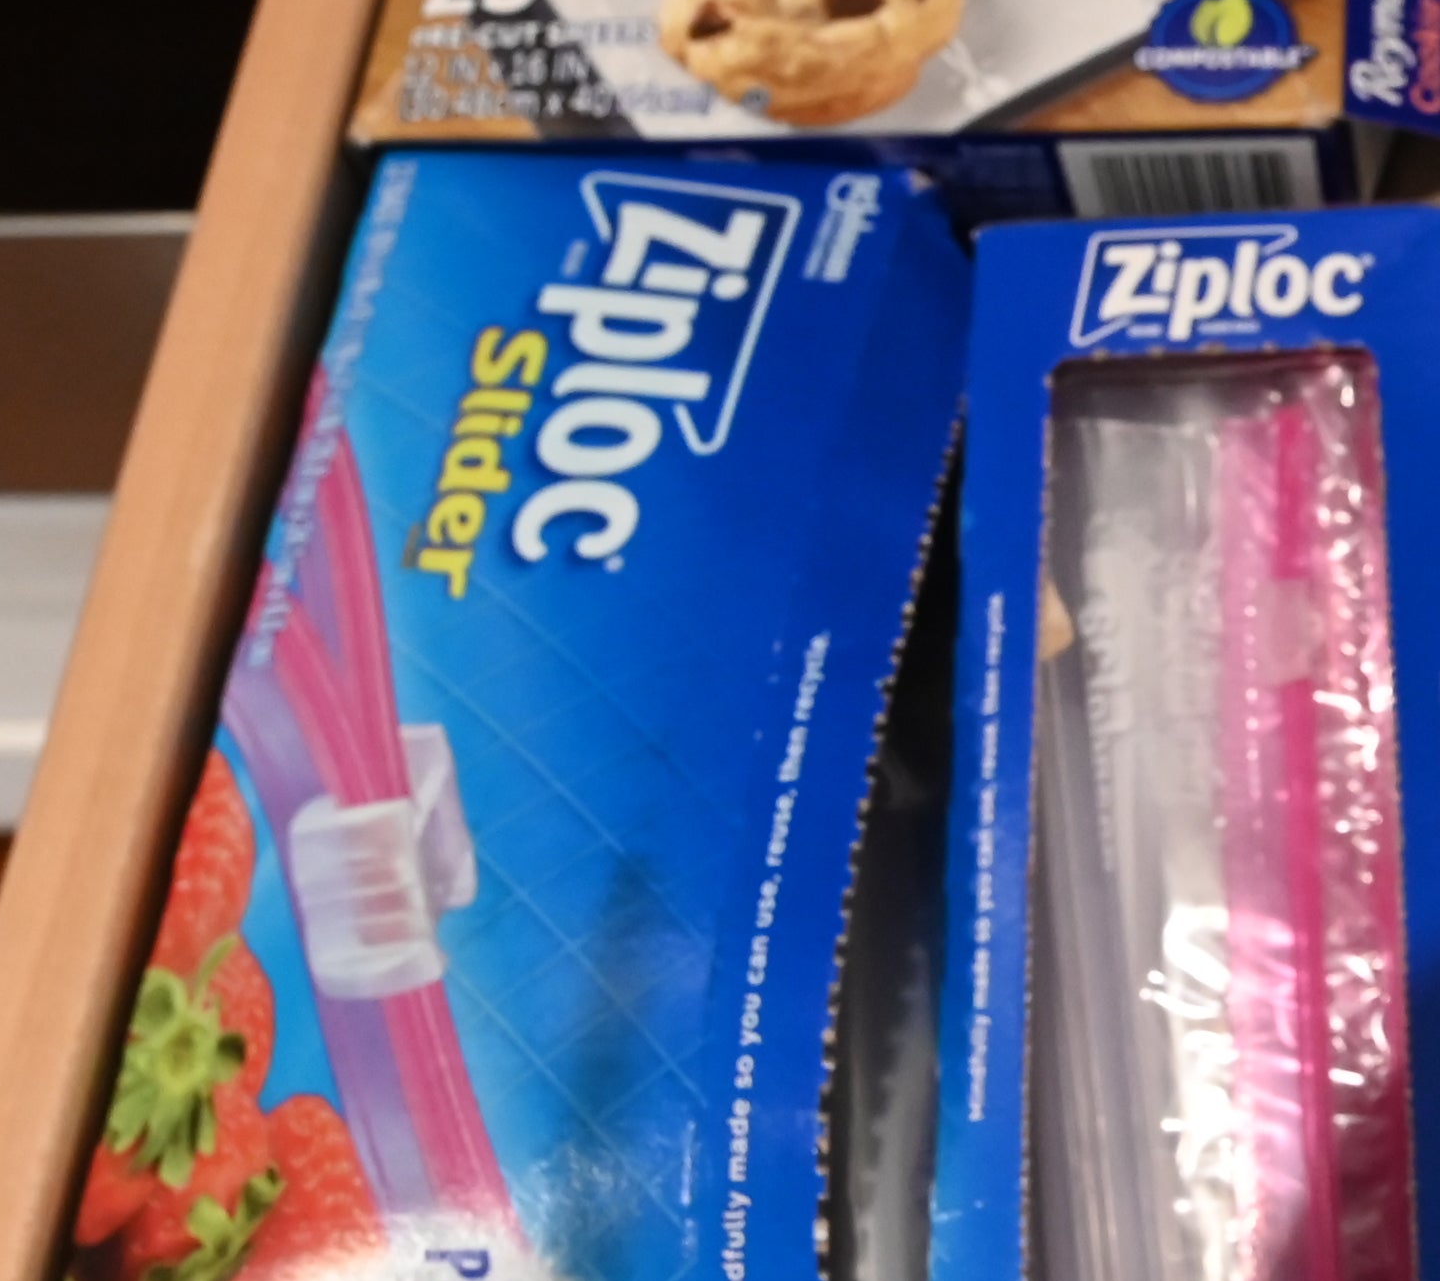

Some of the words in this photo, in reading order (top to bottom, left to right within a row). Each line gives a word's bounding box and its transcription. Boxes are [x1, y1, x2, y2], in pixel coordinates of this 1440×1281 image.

[1134, 44, 1308, 72] COMPOSTABLE
[1099, 241, 1363, 340] Ziploc
[512, 202, 765, 562] Ziploc
[419, 327, 548, 599] Slider
[777, 725, 807, 782] then
[976, 872, 994, 912] you
[974, 916, 991, 943] so
[747, 935, 769, 986] can
[972, 948, 990, 1009] made
[740, 993, 761, 1046] you
[734, 1054, 754, 1089] so
[968, 1014, 991, 1122] Mindfully
[728, 1098, 751, 1182] made
